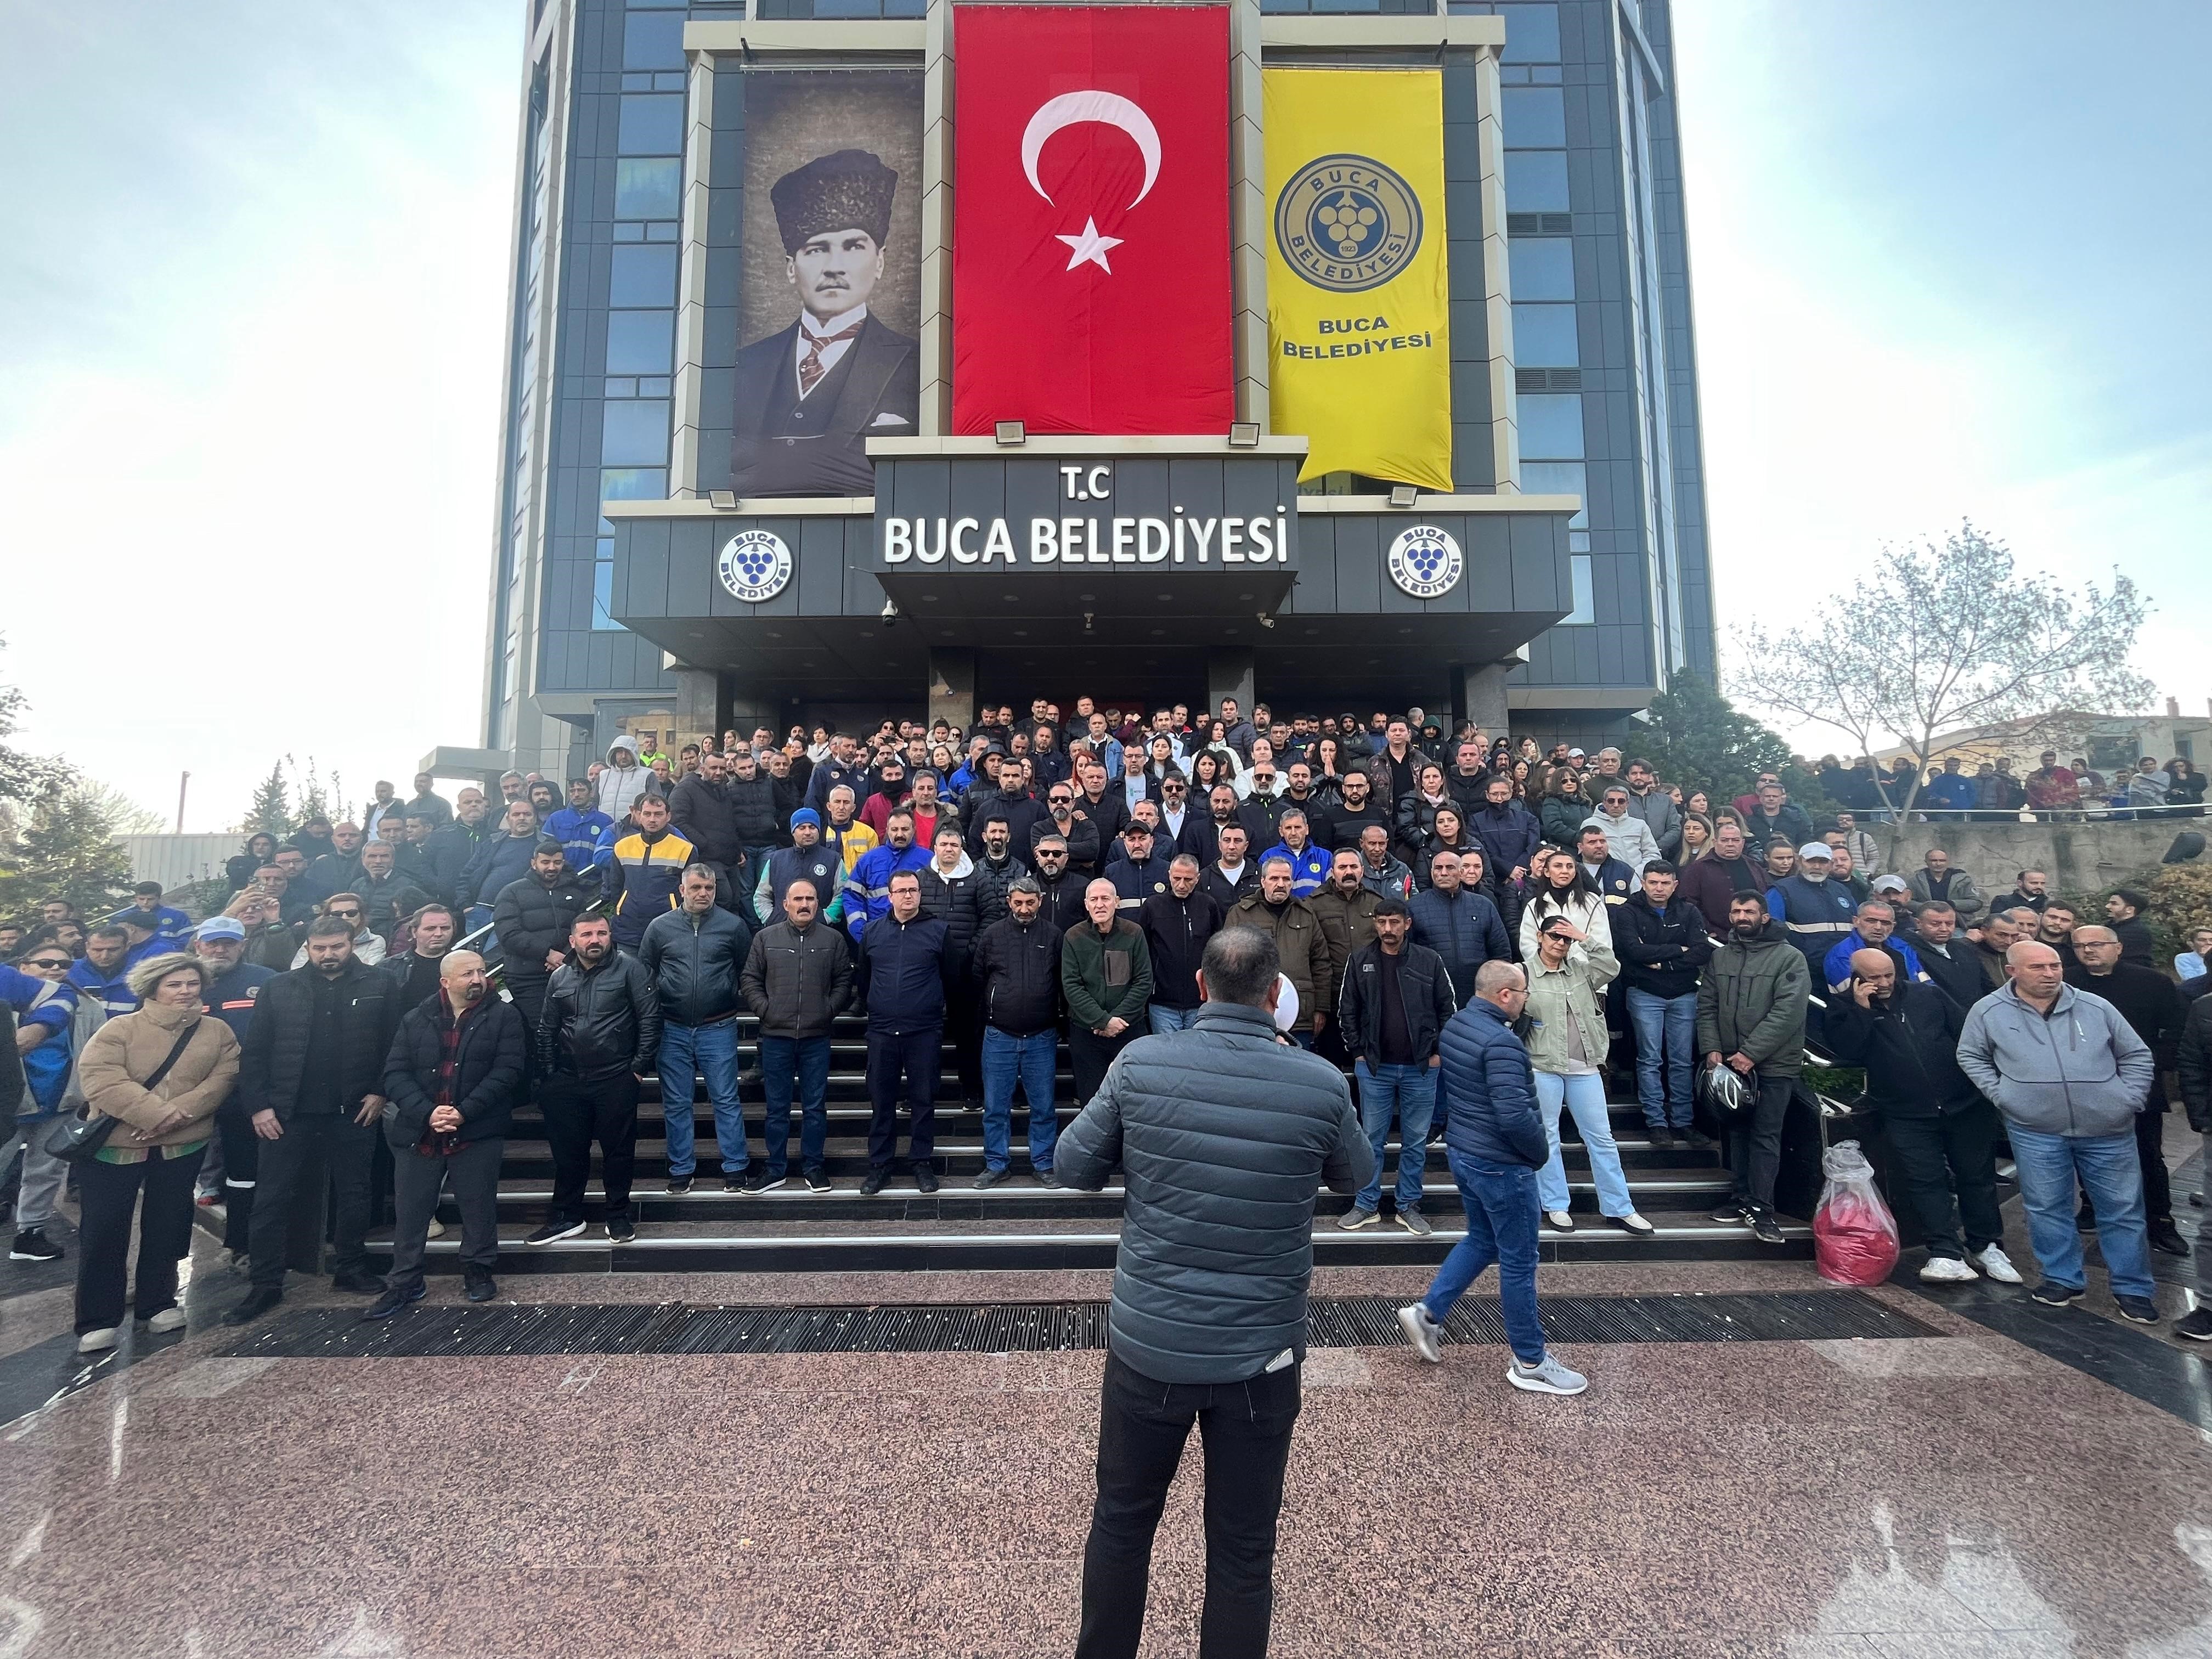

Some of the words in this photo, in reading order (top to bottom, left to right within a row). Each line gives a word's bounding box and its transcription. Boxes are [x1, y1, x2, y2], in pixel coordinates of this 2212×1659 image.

[1310, 171, 1379, 192] BUCA
[1291, 233, 1406, 279] BELEDİYESİ
[1319, 316, 1389, 334] BUCA
[1283, 331, 1431, 359] BELEDİYESİ
[1060, 465, 1110, 500] T.C
[733, 533, 776, 548] BUCA
[885, 517, 1017, 565] BUCA
[1031, 505, 1288, 565] BELEDİYESİ
[1403, 528, 1446, 543] BUCA
